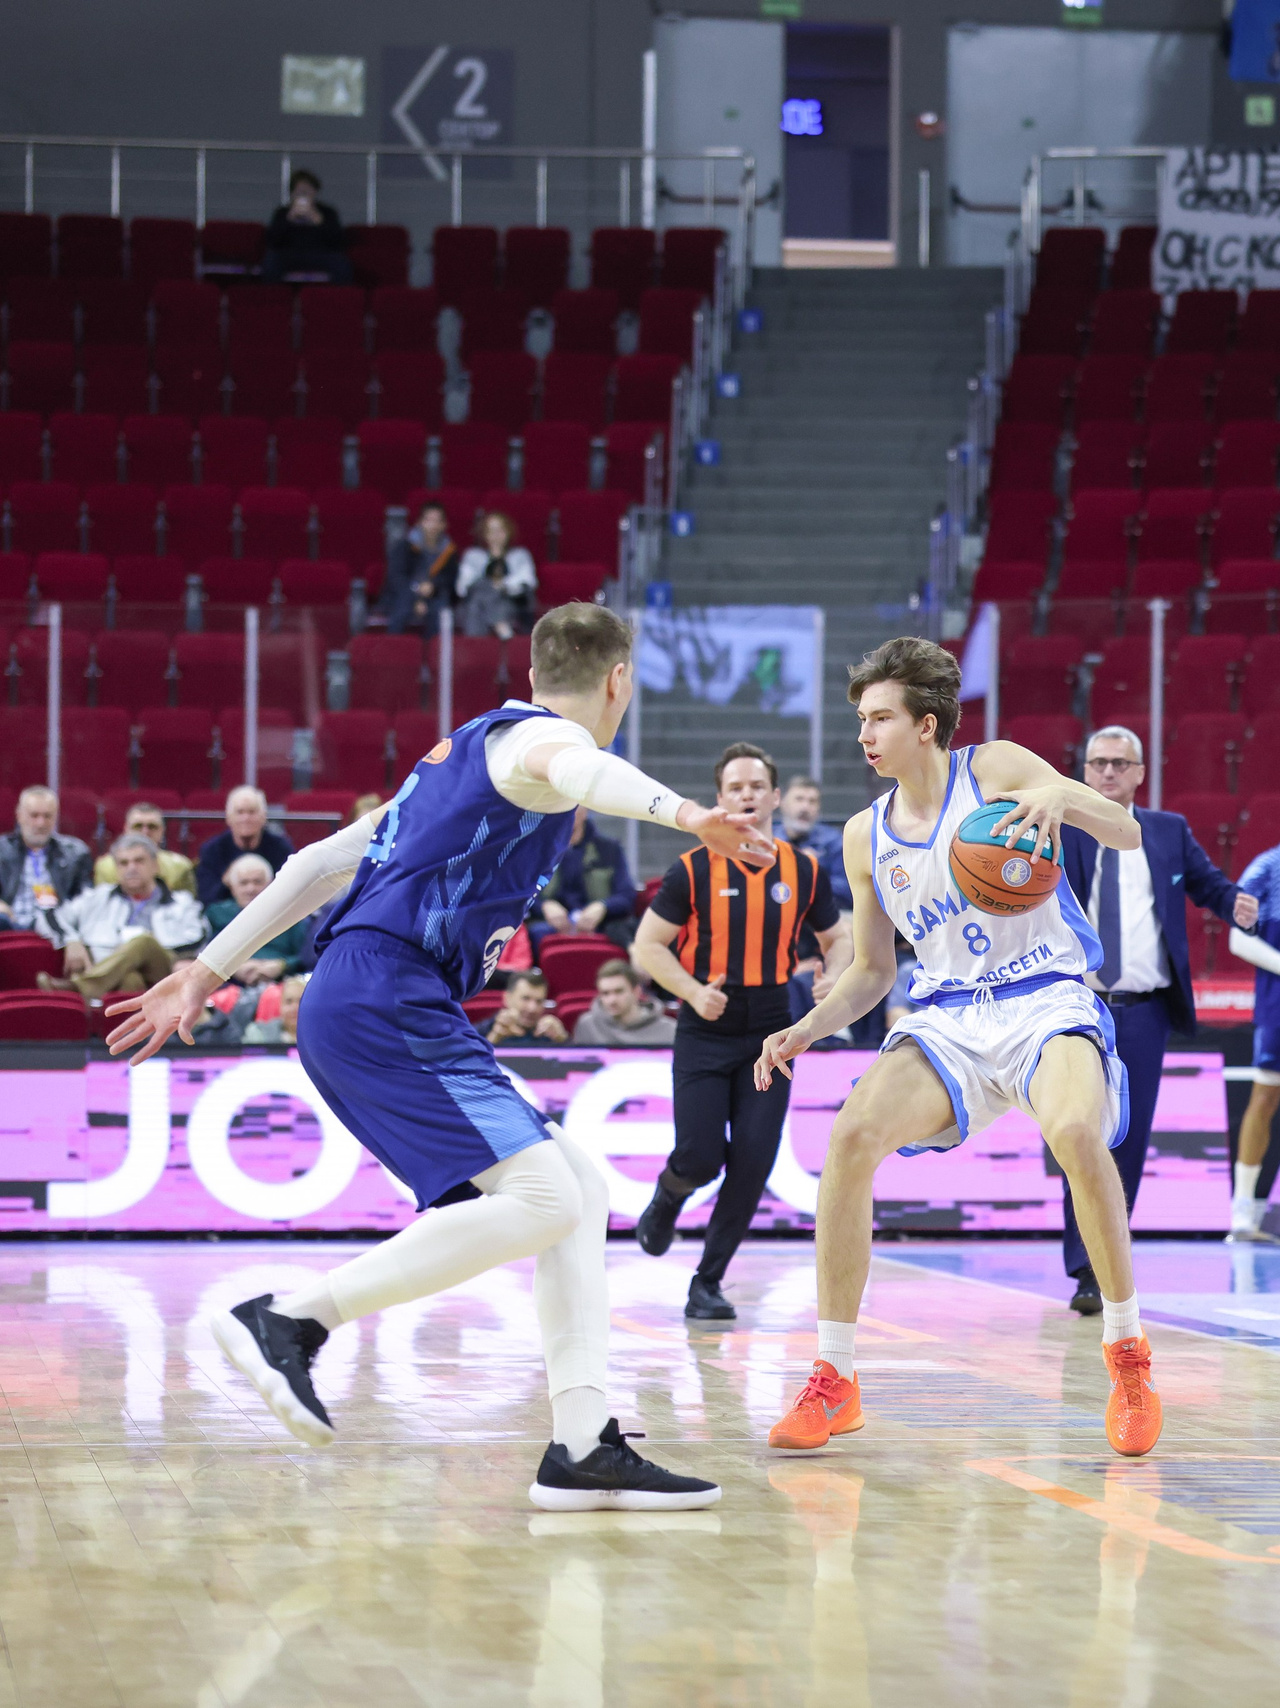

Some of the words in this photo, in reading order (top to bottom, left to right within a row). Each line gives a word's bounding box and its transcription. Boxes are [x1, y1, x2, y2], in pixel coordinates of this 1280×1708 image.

[454, 58, 487, 117] 2
[877, 848, 900, 865] ZEDO
[906, 891, 971, 941] SAMA
[962, 922, 992, 957] 8
